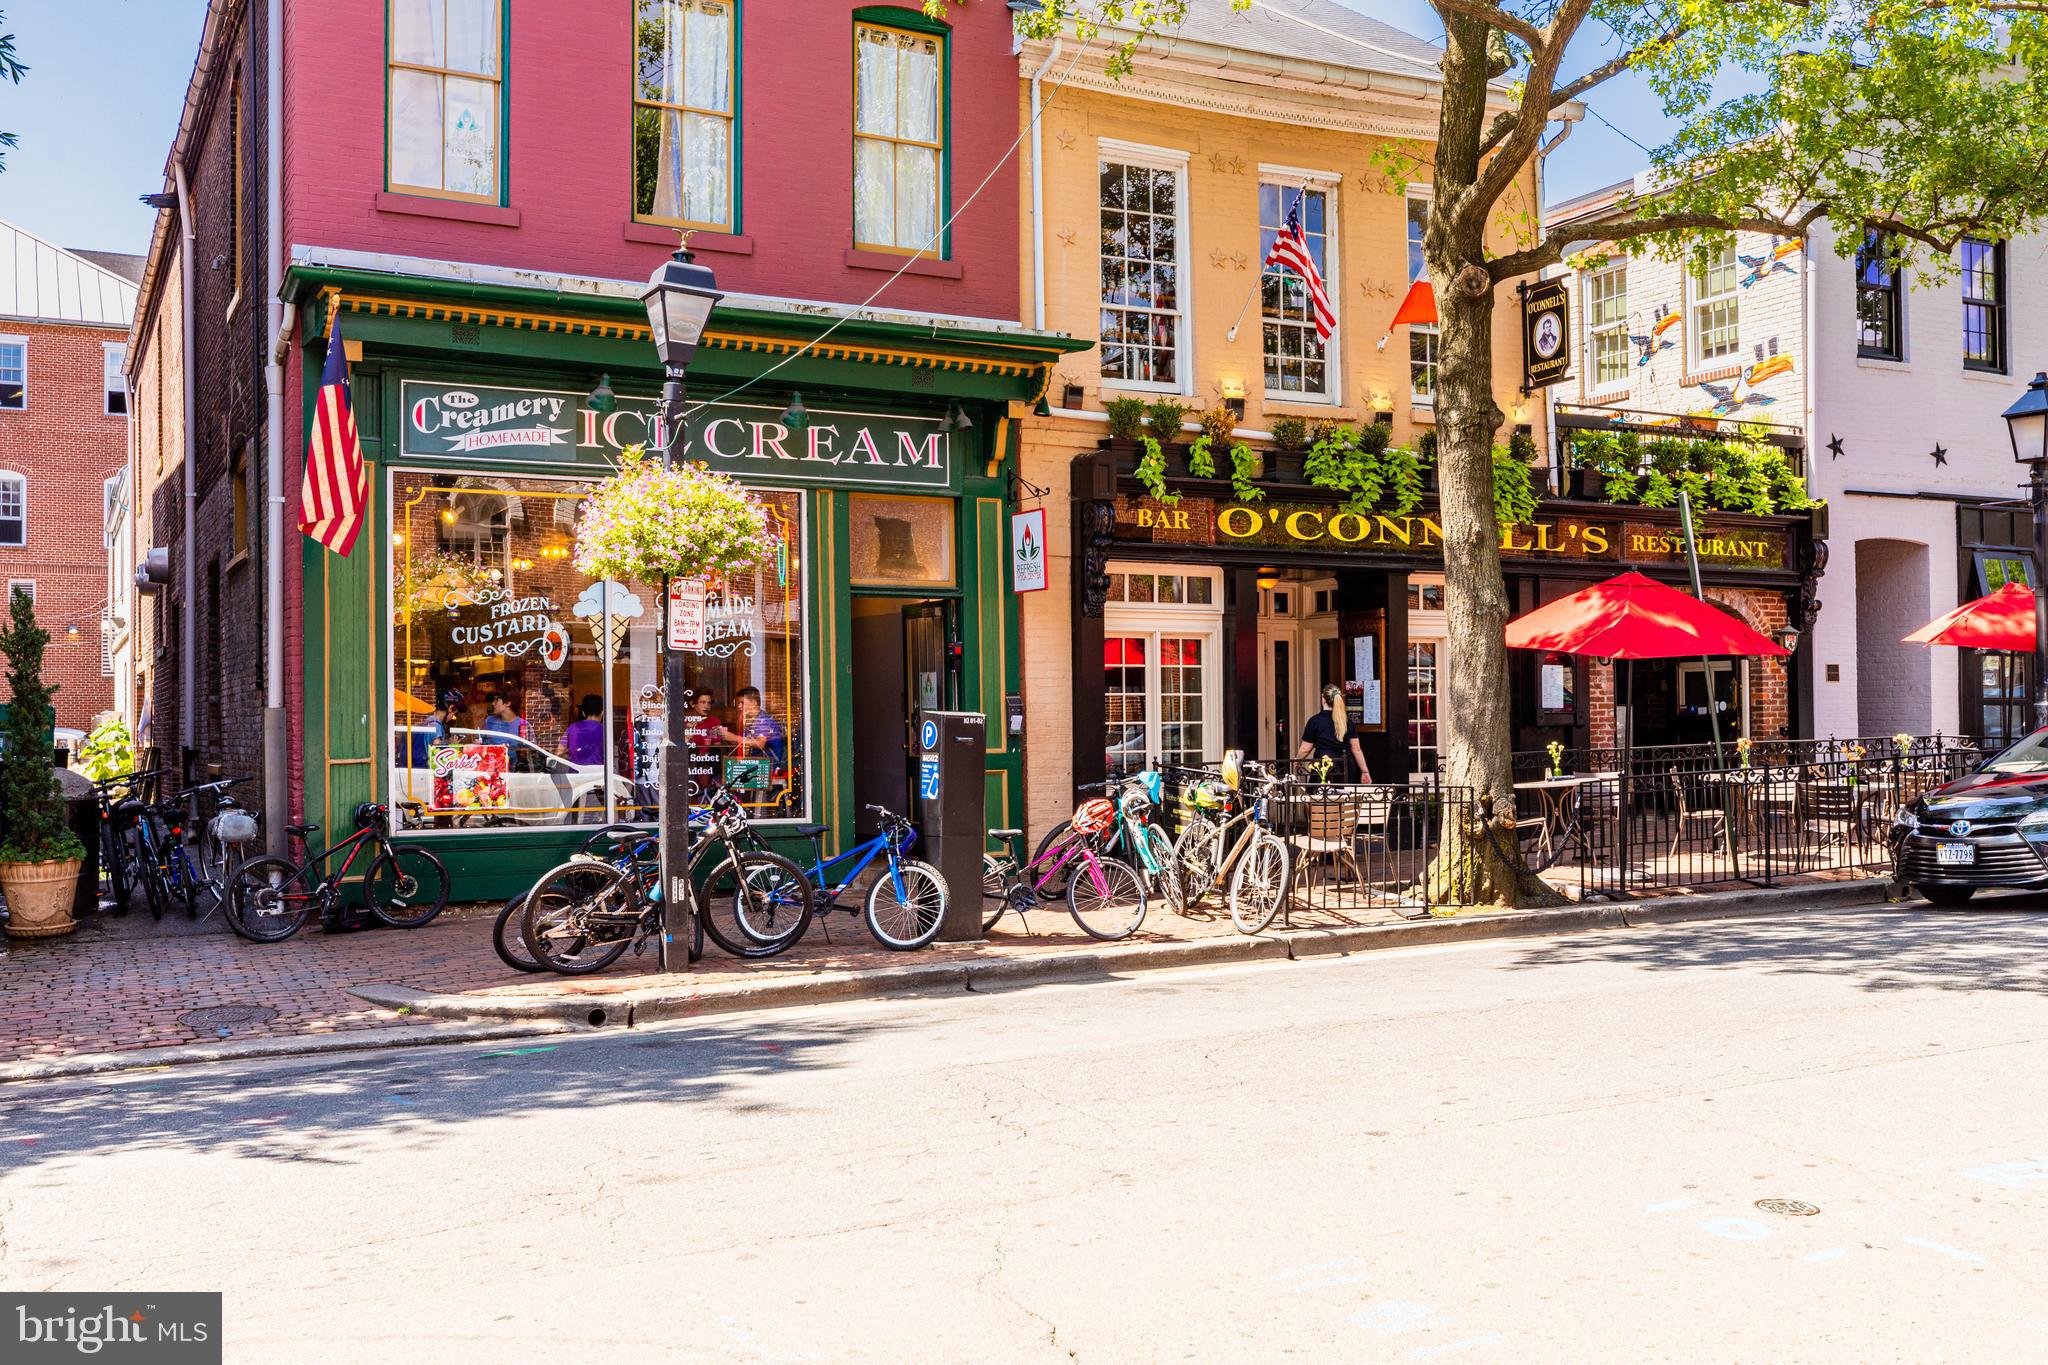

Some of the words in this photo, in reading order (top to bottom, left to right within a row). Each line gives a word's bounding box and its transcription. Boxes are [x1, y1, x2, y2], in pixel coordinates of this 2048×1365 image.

[1528, 294, 1565, 314] O'CONNELL'S
[1530, 357, 1565, 373] RESTAURANT
[447, 395, 475, 404] The
[412, 396, 566, 434] Creamery
[469, 431, 547, 447] HOMEMADE
[703, 417, 944, 469] CREAM
[1137, 508, 1191, 530] BAR
[1217, 507, 1609, 554] O'CONNLL'S
[1632, 535, 1768, 557] RESTURANT
[1017, 561, 1041, 573] REFRESH
[681, 585, 702, 595] ARKING
[491, 597, 550, 619] FROZEN
[452, 614, 550, 644] CUSTARD
[704, 619, 755, 643] REAM
[926, 726, 933, 744] P
[434, 748, 481, 777] Sorbet
[690, 754, 720, 762] Sorbet
